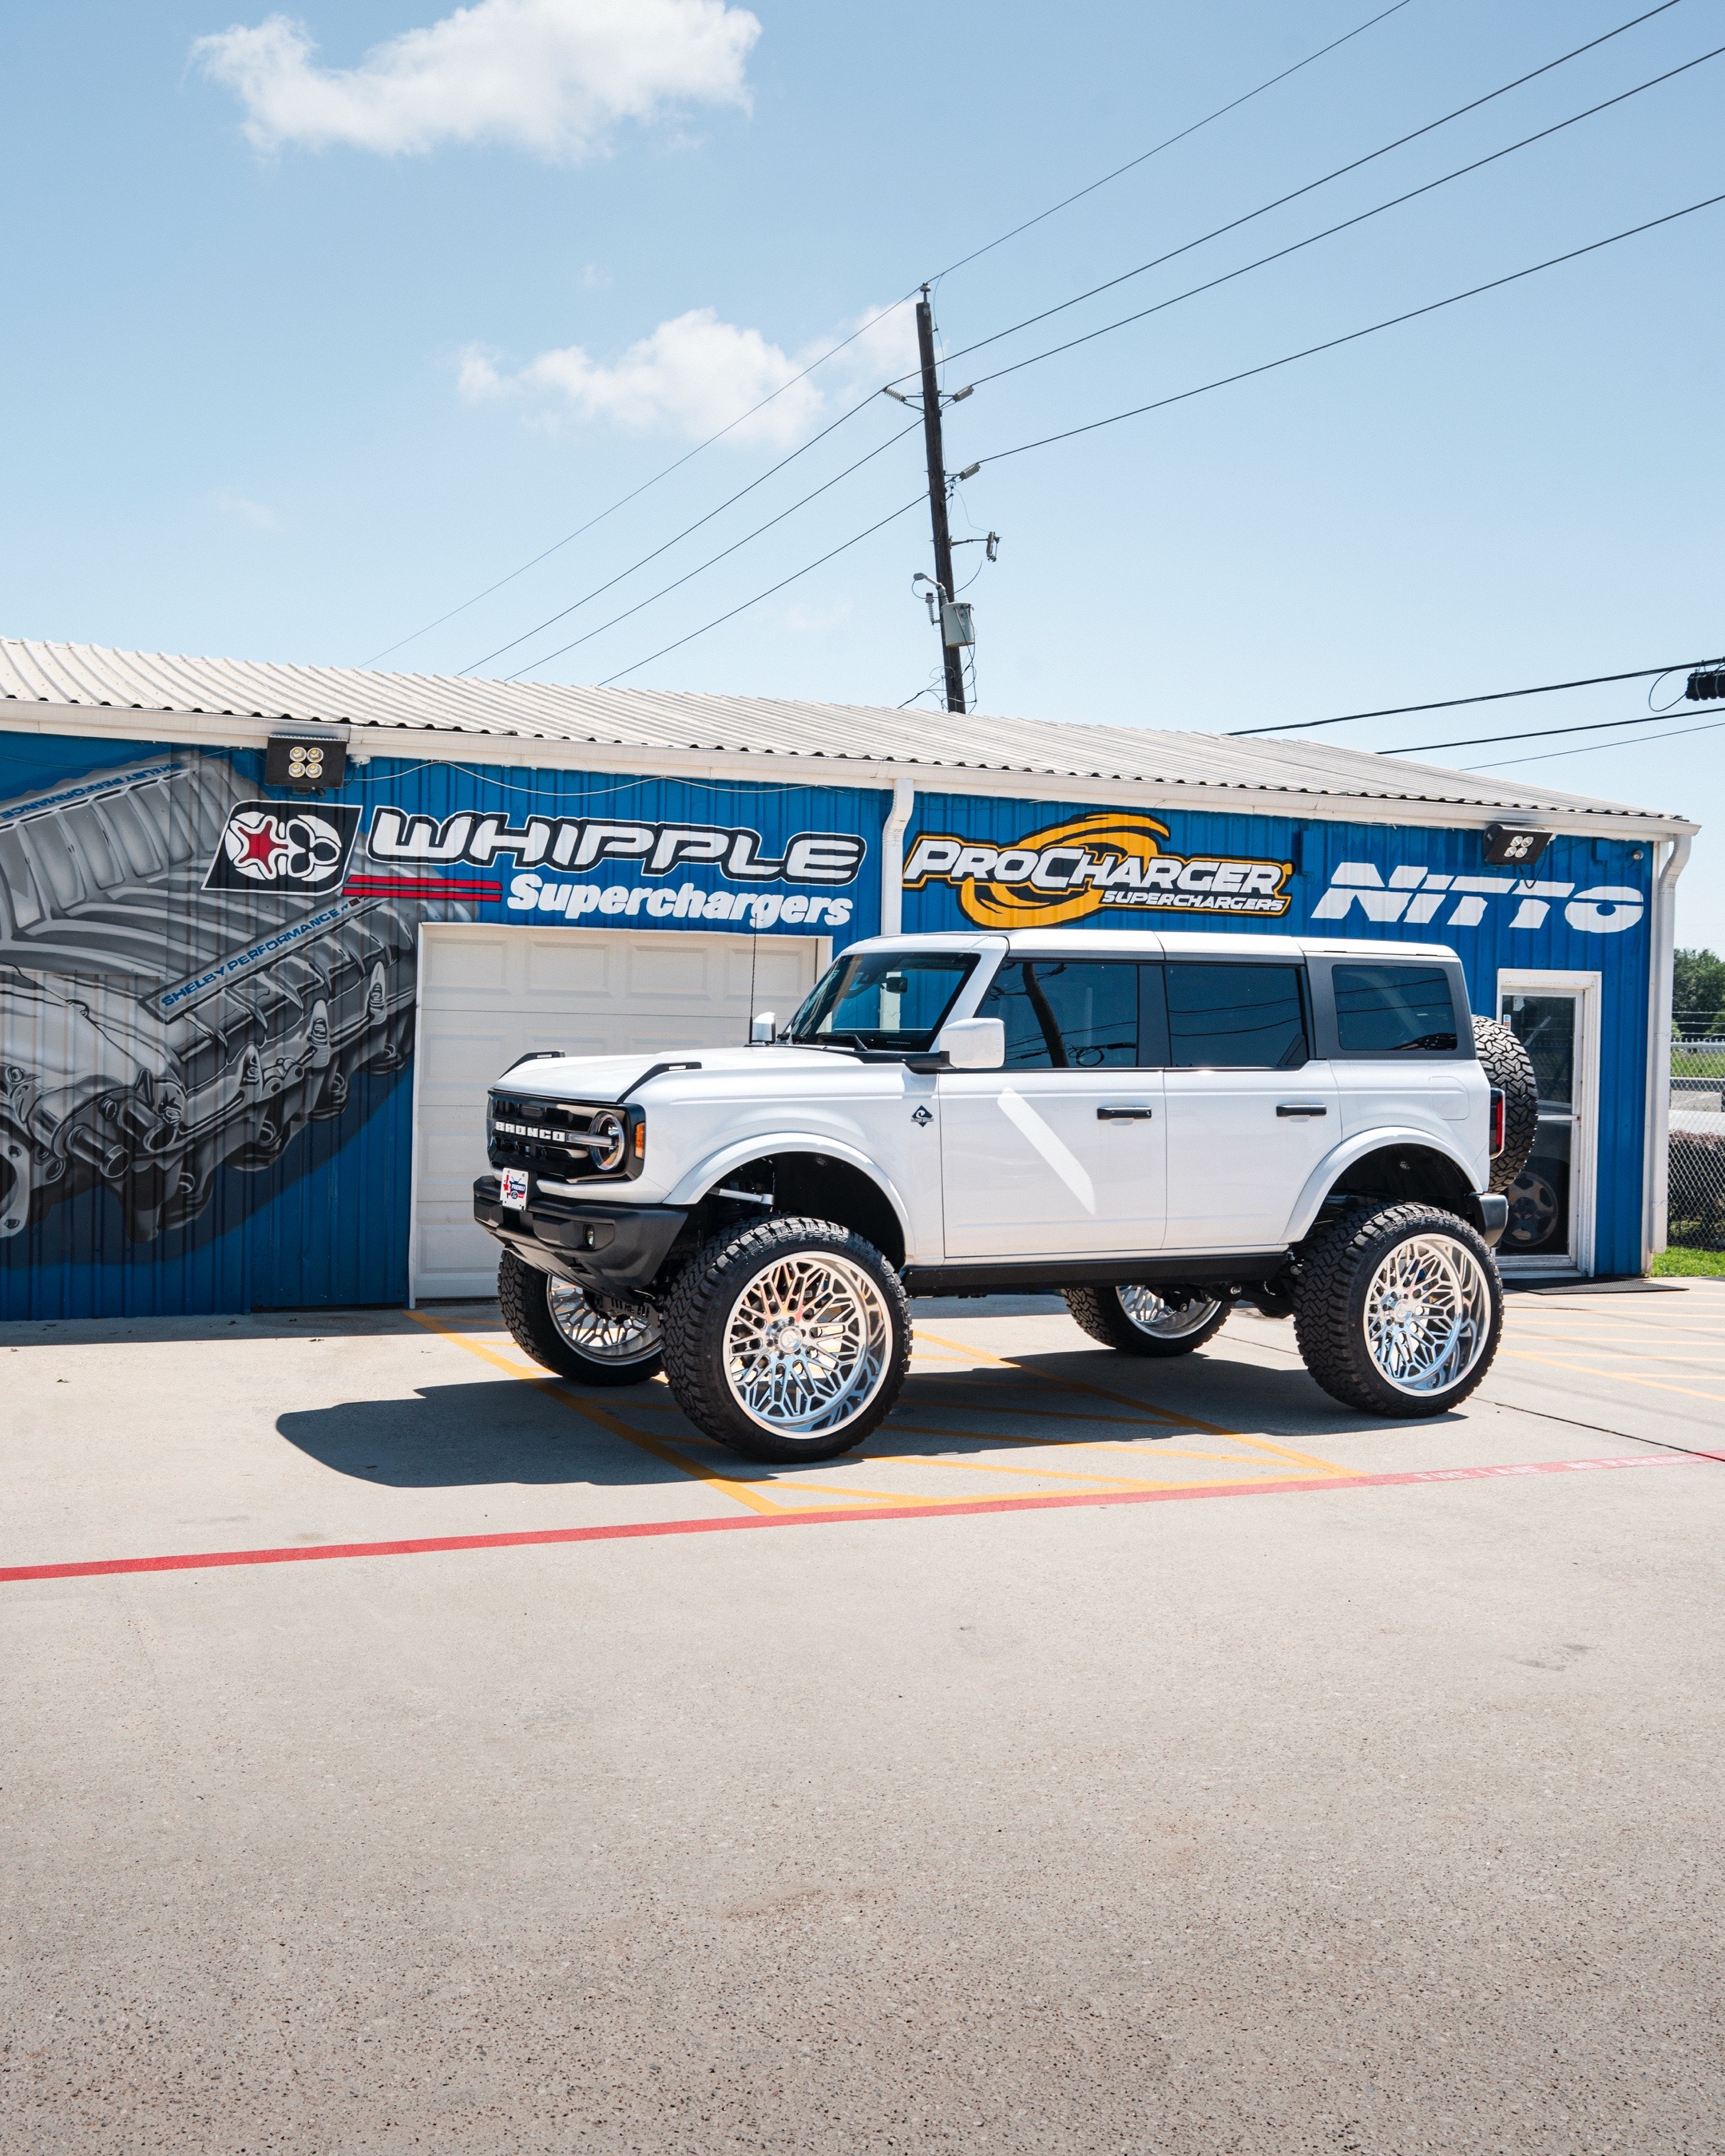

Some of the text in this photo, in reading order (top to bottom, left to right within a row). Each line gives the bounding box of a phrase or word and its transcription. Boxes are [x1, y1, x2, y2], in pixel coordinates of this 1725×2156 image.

[0, 763, 183, 819] SHELBY PERFORMANCE
[367, 806, 866, 886] WHIPPLE
[506, 874, 854, 929] Superchargers
[1100, 890, 1285, 912] SUPERCHARGERS
[1311, 862, 1644, 933] NITTO
[161, 908, 341, 1006] SHELBY PERFORMANCE
[495, 1121, 565, 1141] BRONCO
[1414, 1470, 1477, 1480] FIRE
[1476, 1465, 1548, 1476] LANE
[1564, 1460, 1603, 1470] NO
